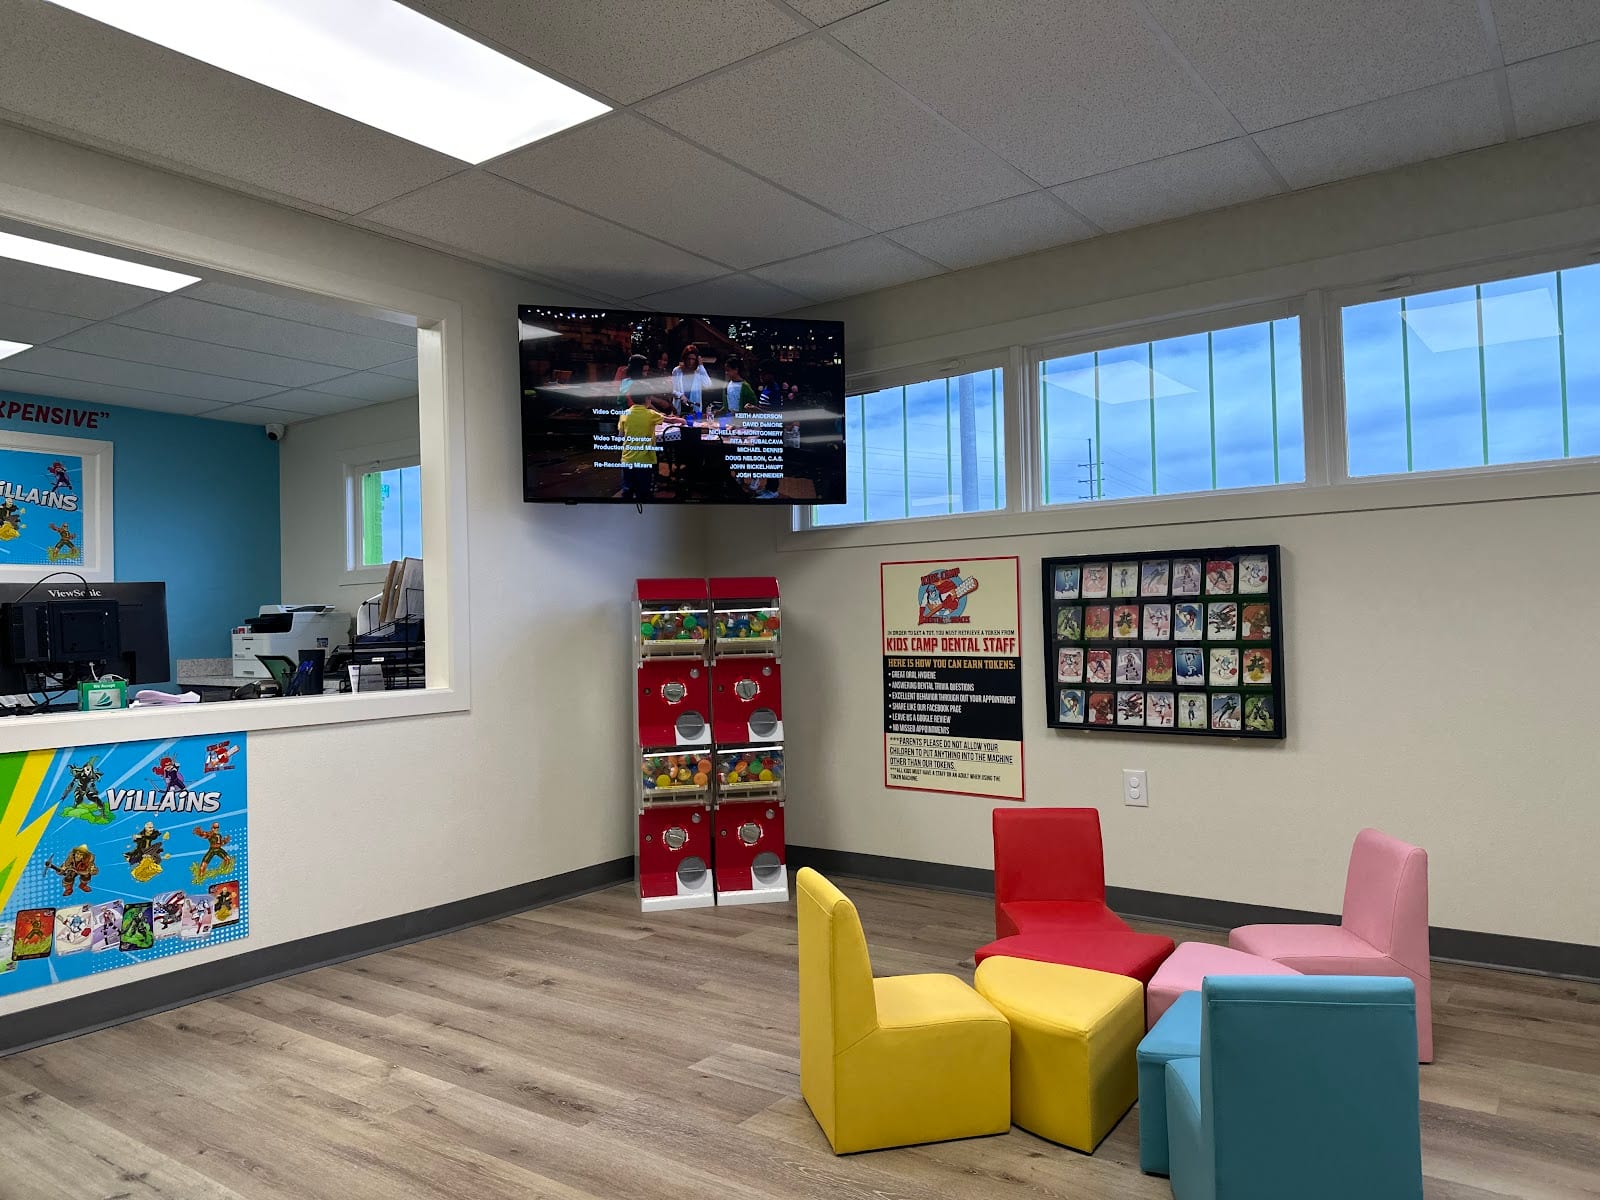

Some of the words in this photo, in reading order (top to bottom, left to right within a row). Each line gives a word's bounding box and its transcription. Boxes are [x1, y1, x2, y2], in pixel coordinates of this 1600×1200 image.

[887, 638, 908, 651] KIDS
[911, 638, 938, 653] CAMP
[941, 638, 980, 652] DENTAL
[982, 638, 1016, 654] STAFF
[888, 658, 906, 668] HERE
[908, 659, 914, 668] IS
[915, 659, 931, 668] HOW
[933, 659, 946, 668] YOU
[948, 659, 962, 669] CAN
[964, 659, 982, 669] EARN
[984, 660, 1016, 670] TOKENS:
[918, 671, 936, 679] HYGIENE
[892, 681, 917, 689] ANSWERING
[918, 682, 934, 690] DENTAL
[950, 682, 974, 691] QUESTIONS
[892, 692, 916, 700] EXCELLENT
[939, 693, 959, 702] THROUGH
[960, 694, 968, 702] OUT
[970, 694, 982, 703] YOUR
[983, 695, 1016, 704] APPOINTMENT
[927, 704, 949, 712] FACEBOOK
[950, 705, 962, 713] PAGE
[917, 714, 933, 722] GOOGLE
[934, 715, 951, 723] REVIEW
[900, 724, 915, 732] MISSED
[916, 725, 949, 734] APPOINTMENTS
[924, 739, 942, 747] PLEASE
[952, 740, 962, 748] NOT
[964, 741, 982, 750] ALLOW
[984, 742, 999, 751] YOUR
[890, 746, 914, 756] CHILDREN
[916, 748, 922, 757] TO
[923, 749, 932, 757] PUT
[934, 750, 960, 759] ANYTHING
[962, 752, 974, 760] INTO
[975, 753, 986, 761] THE
[987, 754, 1013, 763] MACHINE
[890, 757, 906, 766] OTHER
[907, 758, 920, 767] THAN
[921, 759, 932, 768] OUR
